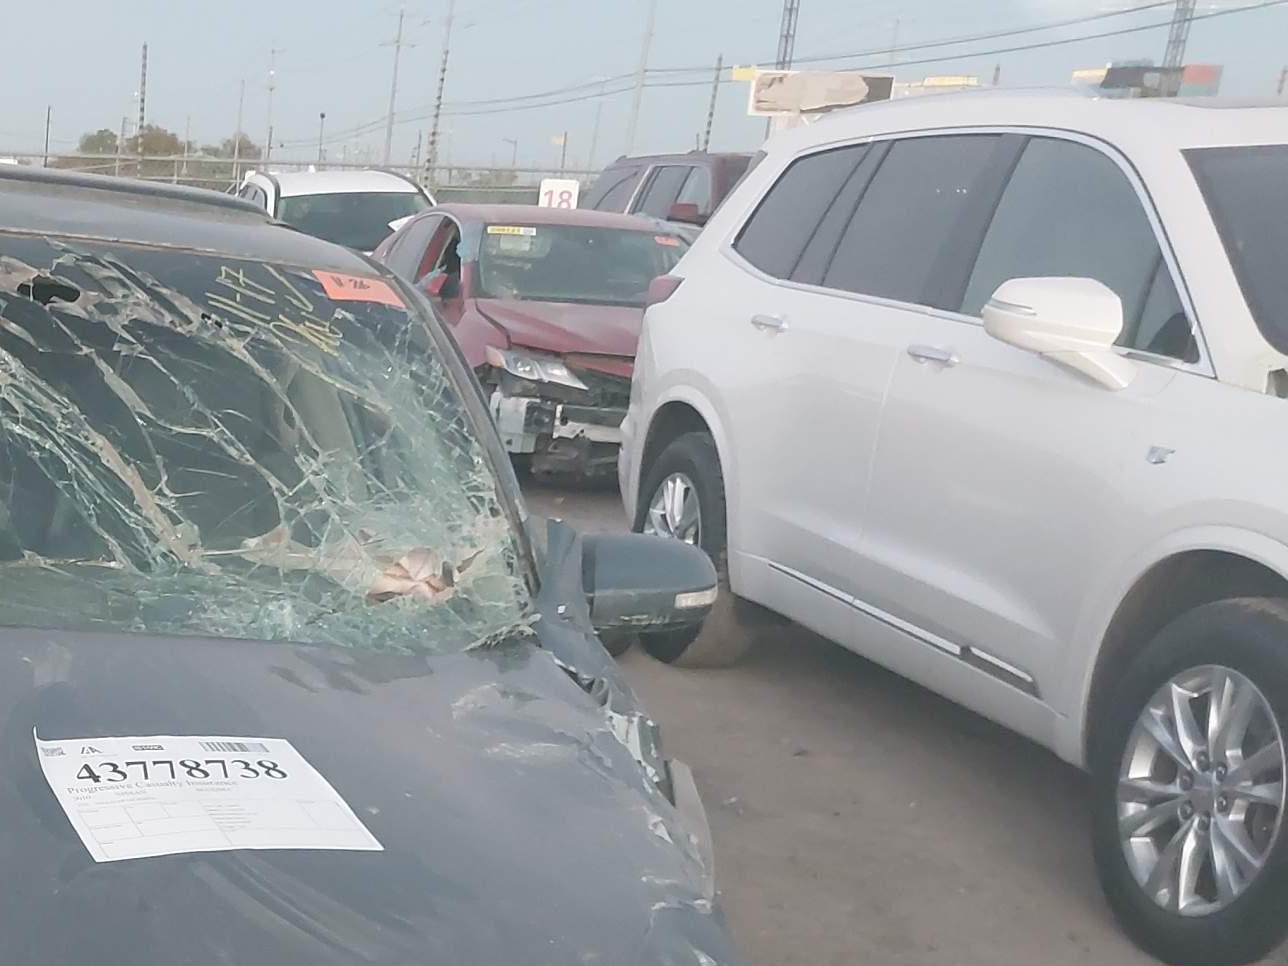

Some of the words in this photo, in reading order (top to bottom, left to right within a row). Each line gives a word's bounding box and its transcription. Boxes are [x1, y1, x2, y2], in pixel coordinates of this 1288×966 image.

[544, 190, 573, 209] 18
[75, 759, 288, 784] 43778738
[67, 782, 133, 794] Progressive
